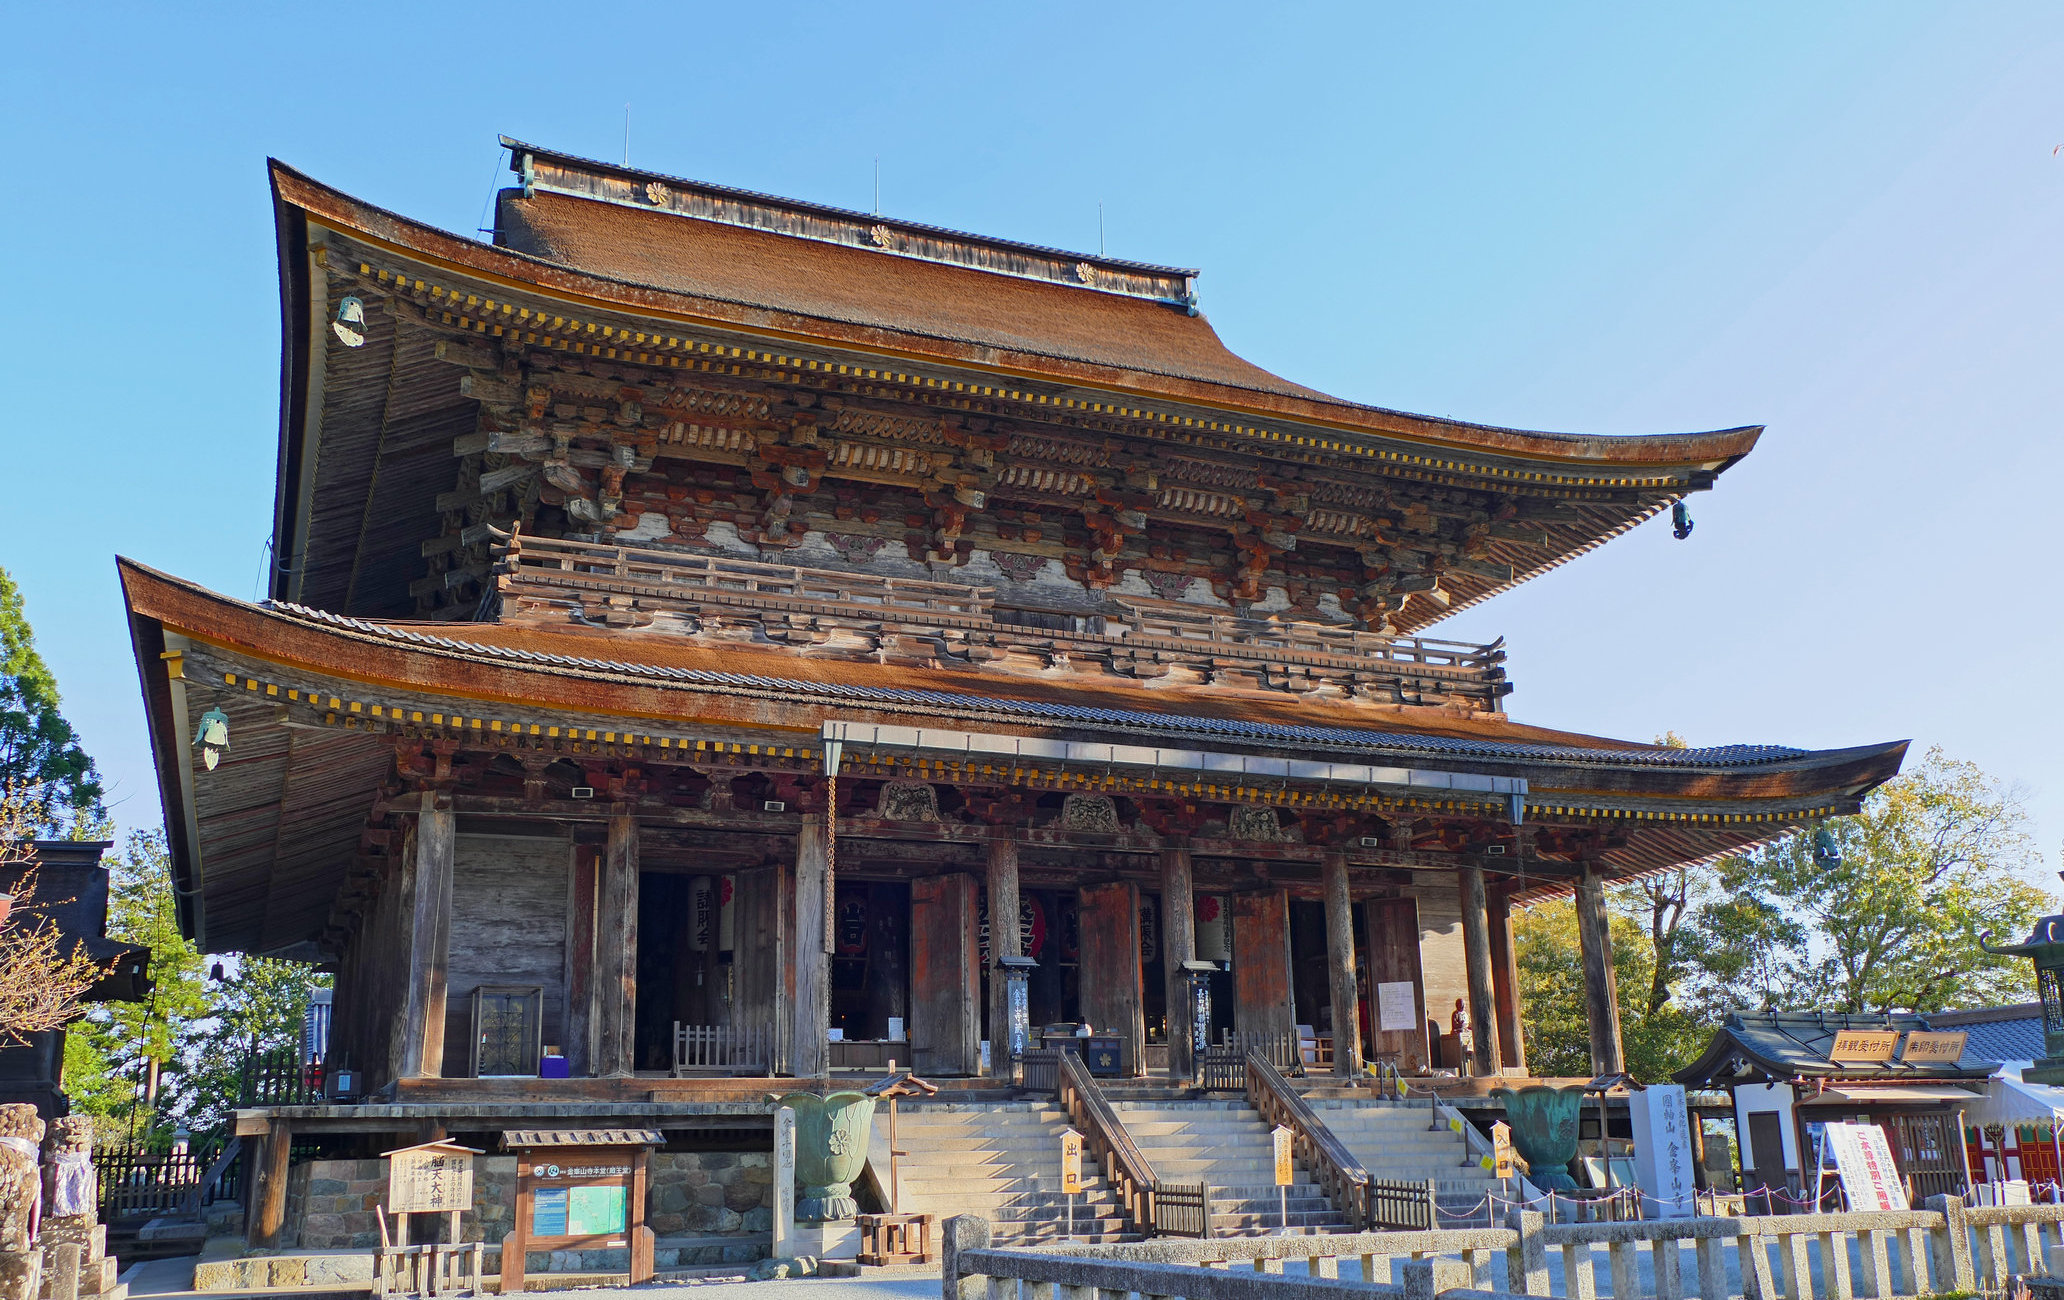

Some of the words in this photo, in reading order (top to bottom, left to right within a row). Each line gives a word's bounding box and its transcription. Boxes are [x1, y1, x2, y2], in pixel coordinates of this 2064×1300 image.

[1836, 1039, 1892, 1052] 拝観受付所
[1066, 1142, 1078, 1184] 出口
[1497, 1134, 1508, 1170] 入口
[430, 1154, 445, 1208] 脳天大神
